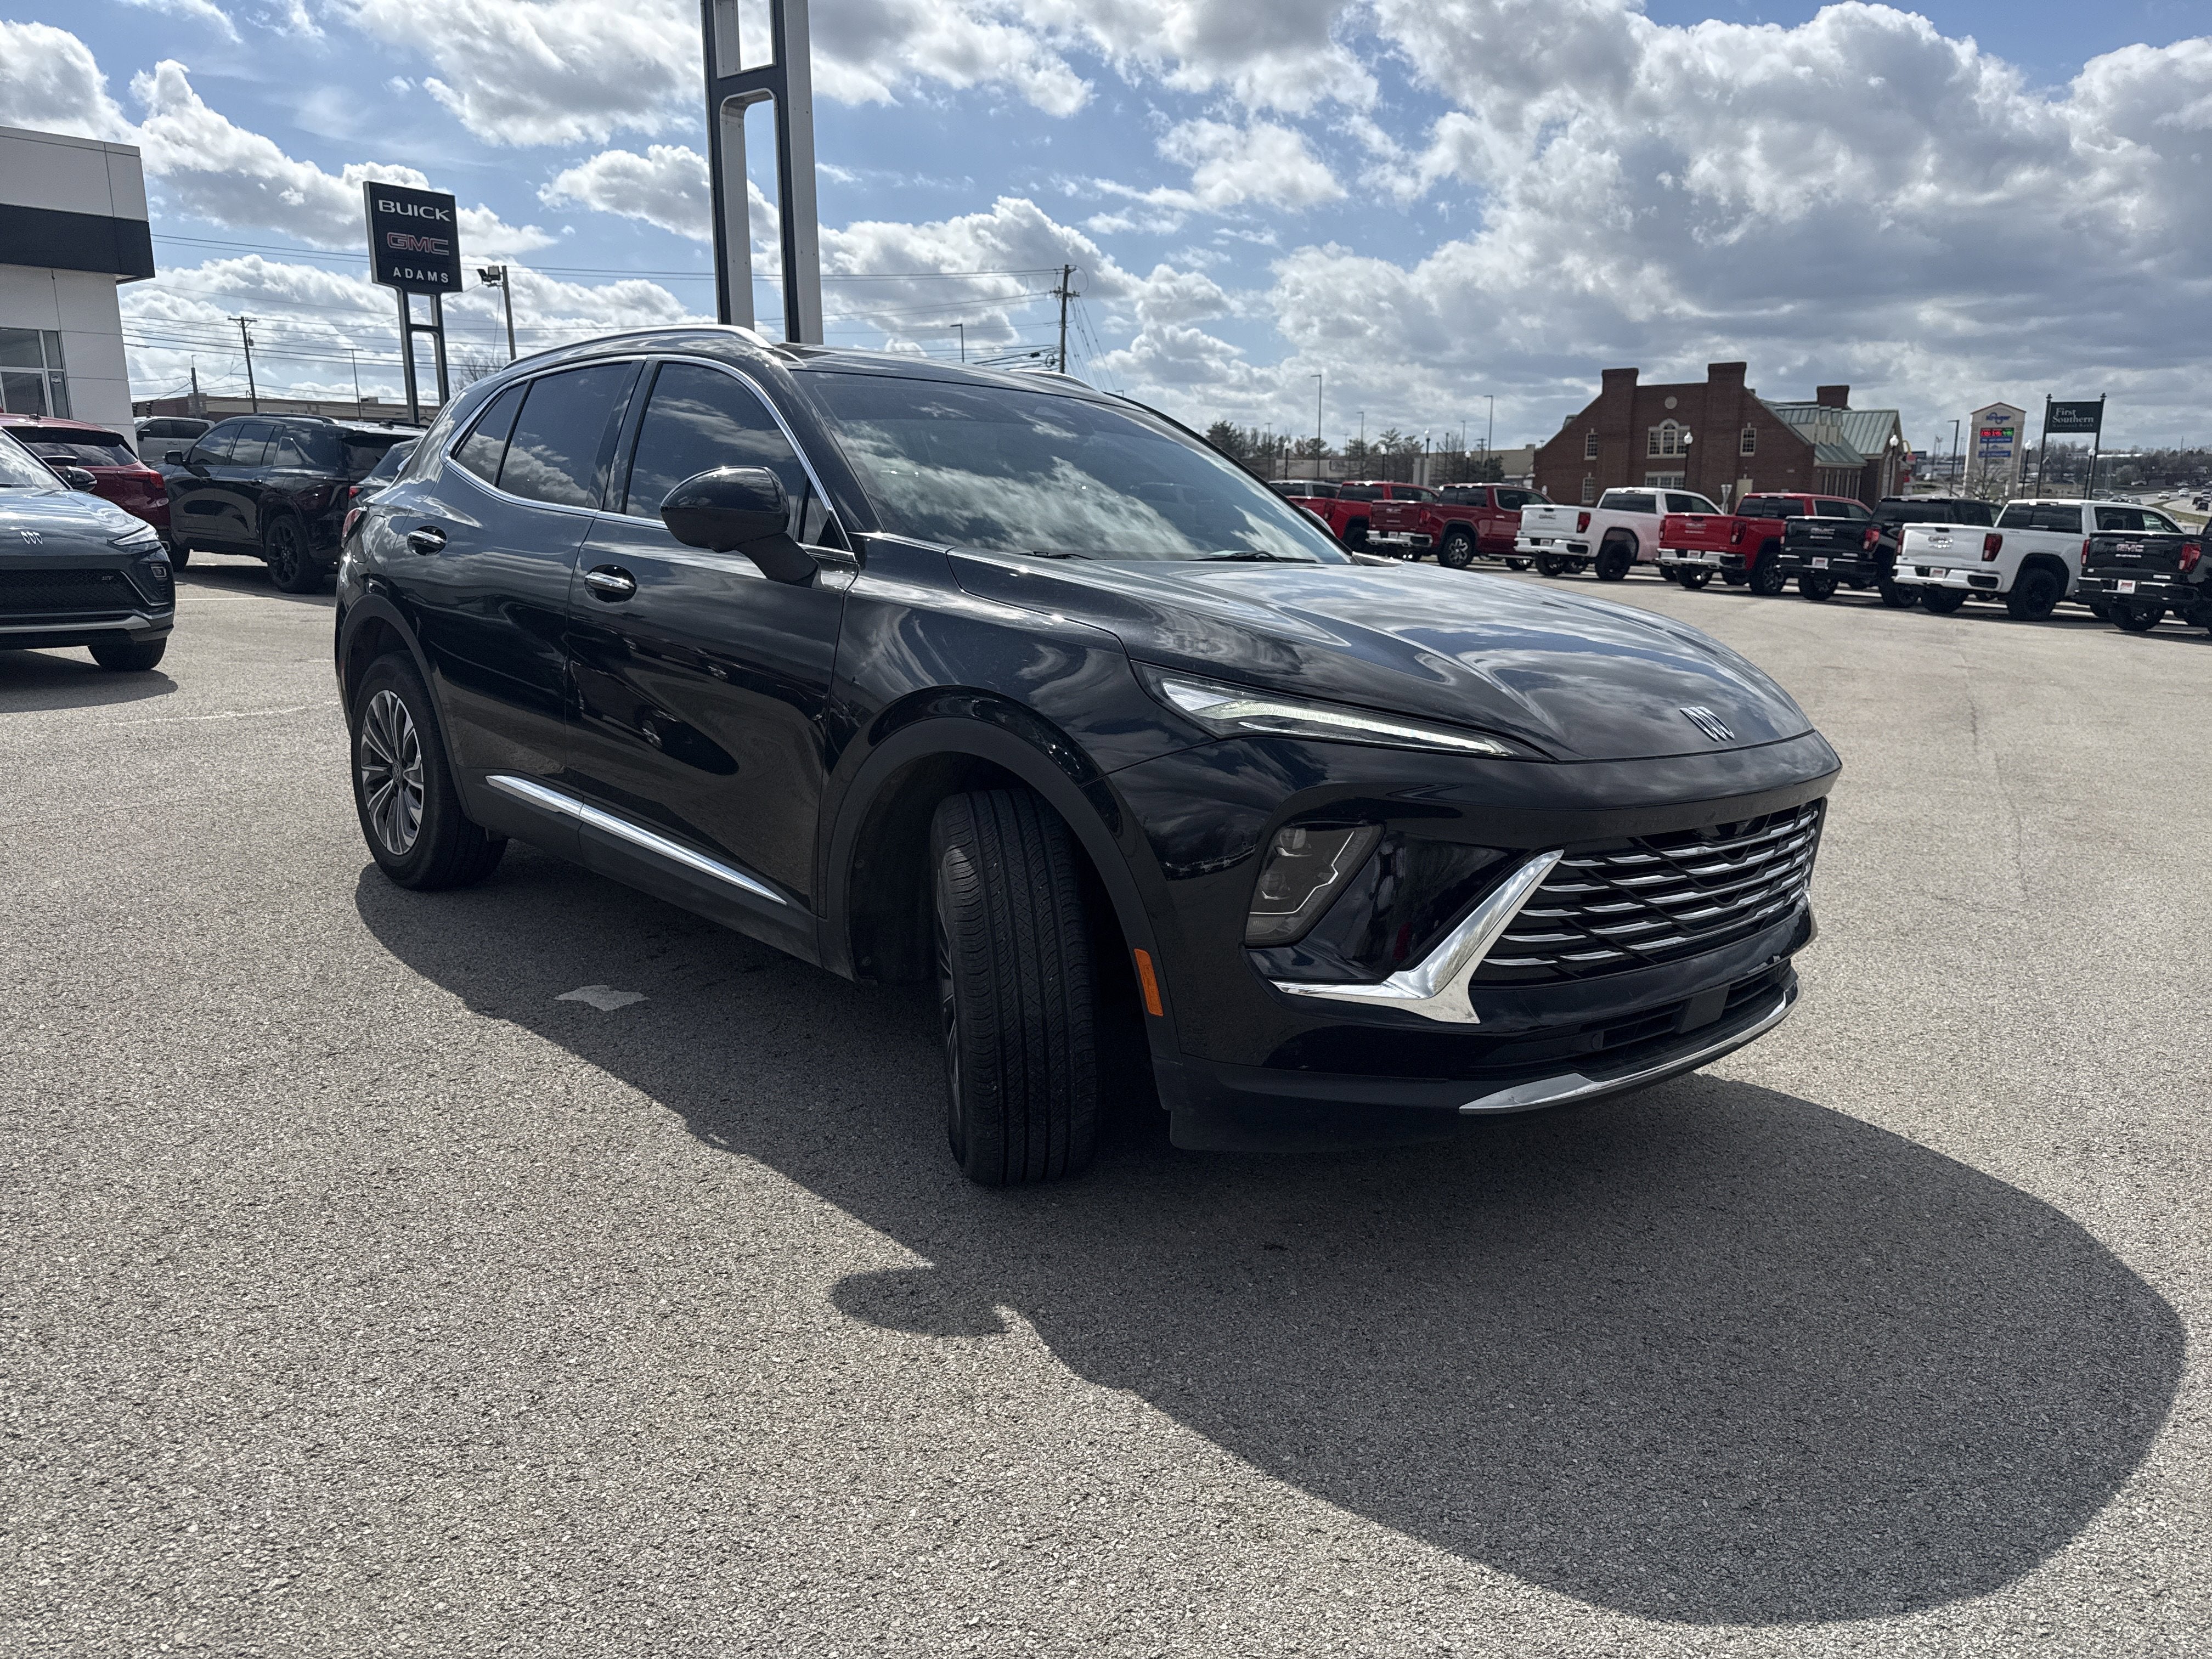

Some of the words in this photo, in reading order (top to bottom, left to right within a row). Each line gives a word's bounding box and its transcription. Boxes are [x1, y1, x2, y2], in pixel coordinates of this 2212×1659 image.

[379, 199, 451, 222] BUICK
[387, 232, 449, 256] GMC
[393, 267, 449, 283] ADAMS
[2052, 415, 2094, 423] Southern
[2056, 408, 2076, 416] First
